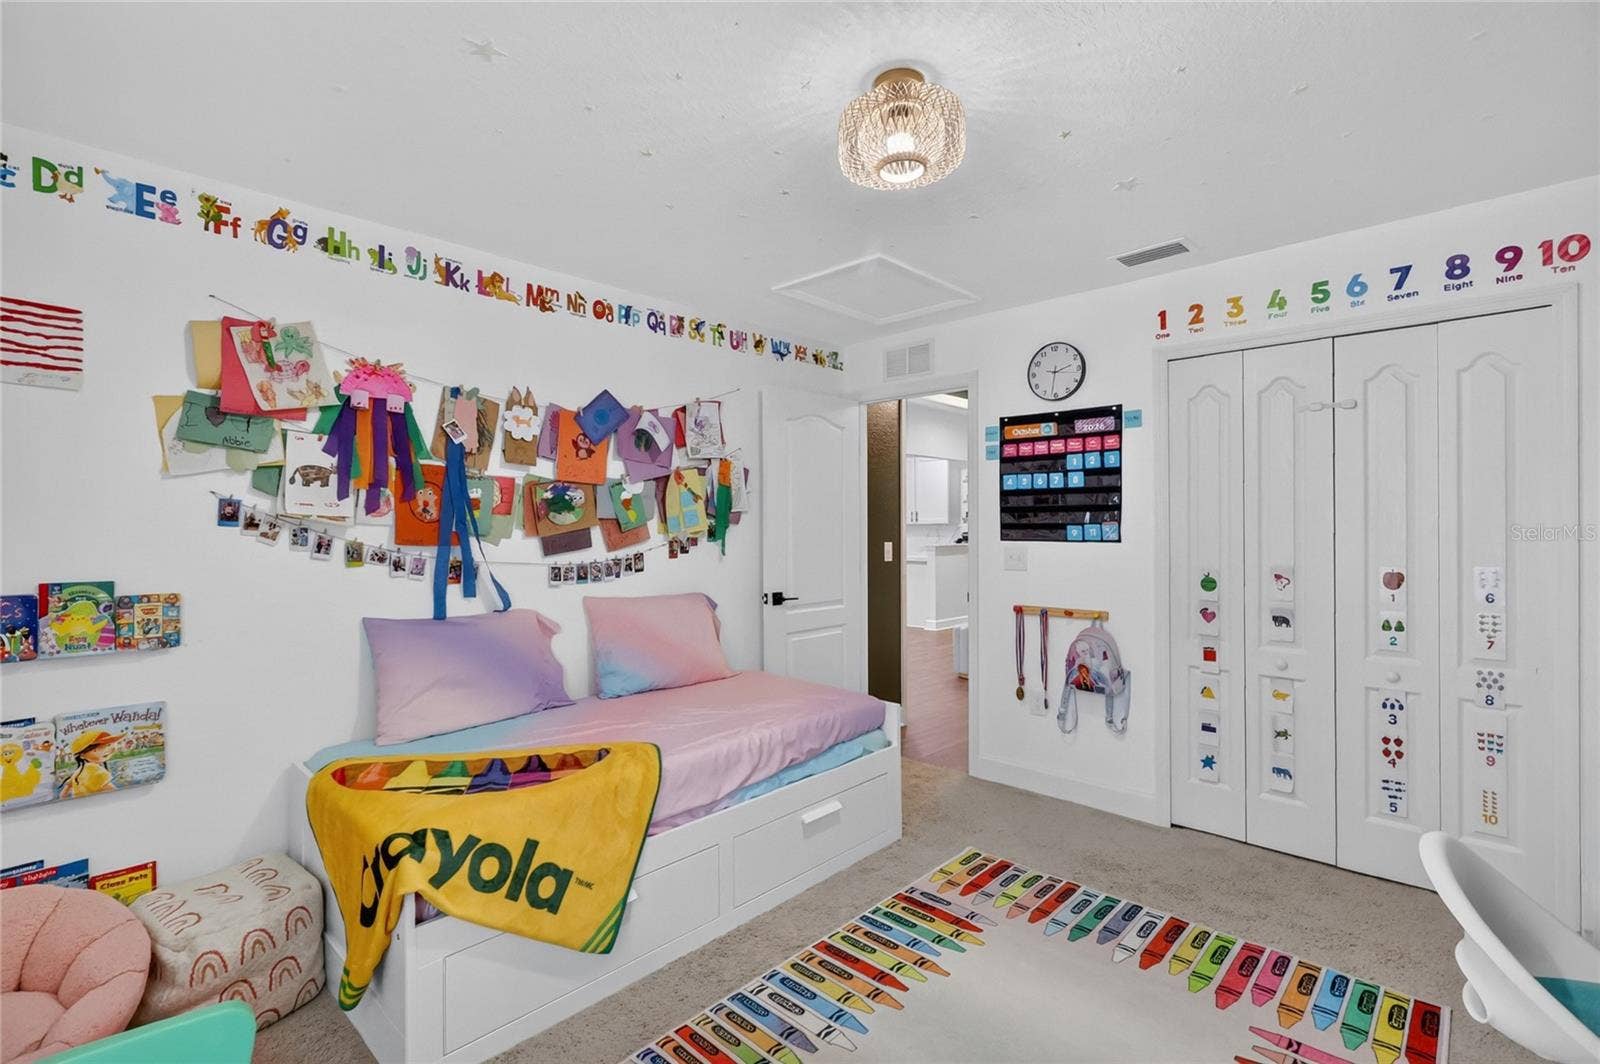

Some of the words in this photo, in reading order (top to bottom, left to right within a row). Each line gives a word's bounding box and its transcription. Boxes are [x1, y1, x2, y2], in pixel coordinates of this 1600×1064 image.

[32, 156, 83, 193] Dd
[135, 182, 177, 220] Ee
[267, 218, 308, 249] Gg
[327, 226, 360, 261] Hh
[1495, 245, 1524, 273] 9
[1537, 233, 1592, 266] 10
[445, 261, 470, 293] Kk
[1390, 264, 1413, 291] 7
[1445, 254, 1471, 280] 8
[1551, 264, 1576, 275] Ten
[1346, 273, 1368, 298] 6
[1443, 280, 1474, 292] Eight
[1496, 273, 1524, 285] Nine
[1267, 289, 1287, 311] 4
[1311, 280, 1331, 304] 5
[1387, 289, 1419, 301] Seven
[566, 293, 586, 314] Nn
[1226, 296, 1244, 319] 3
[1311, 306, 1330, 314] Five
[646, 311, 666, 335] Qq
[1157, 309, 1168, 330] 1
[1188, 304, 1205, 326] 2
[1268, 311, 1288, 320] Four
[1155, 332, 1171, 340] One
[1188, 326, 1205, 334] Two
[222, 436, 251, 448] Abbie
[1485, 592, 1495, 604] 6
[1389, 636, 1398, 646] 2
[1487, 640, 1495, 650] 7
[1485, 694, 1494, 706] 8
[60, 717, 110, 736] Whatever
[110, 707, 162, 723] Wanda!
[1388, 713, 1398, 725] 3
[1388, 758, 1397, 768] 4
[1486, 755, 1496, 767] 9
[1389, 802, 1398, 813] 5
[1482, 813, 1498, 825] 10
[360, 828, 574, 928] ayola
